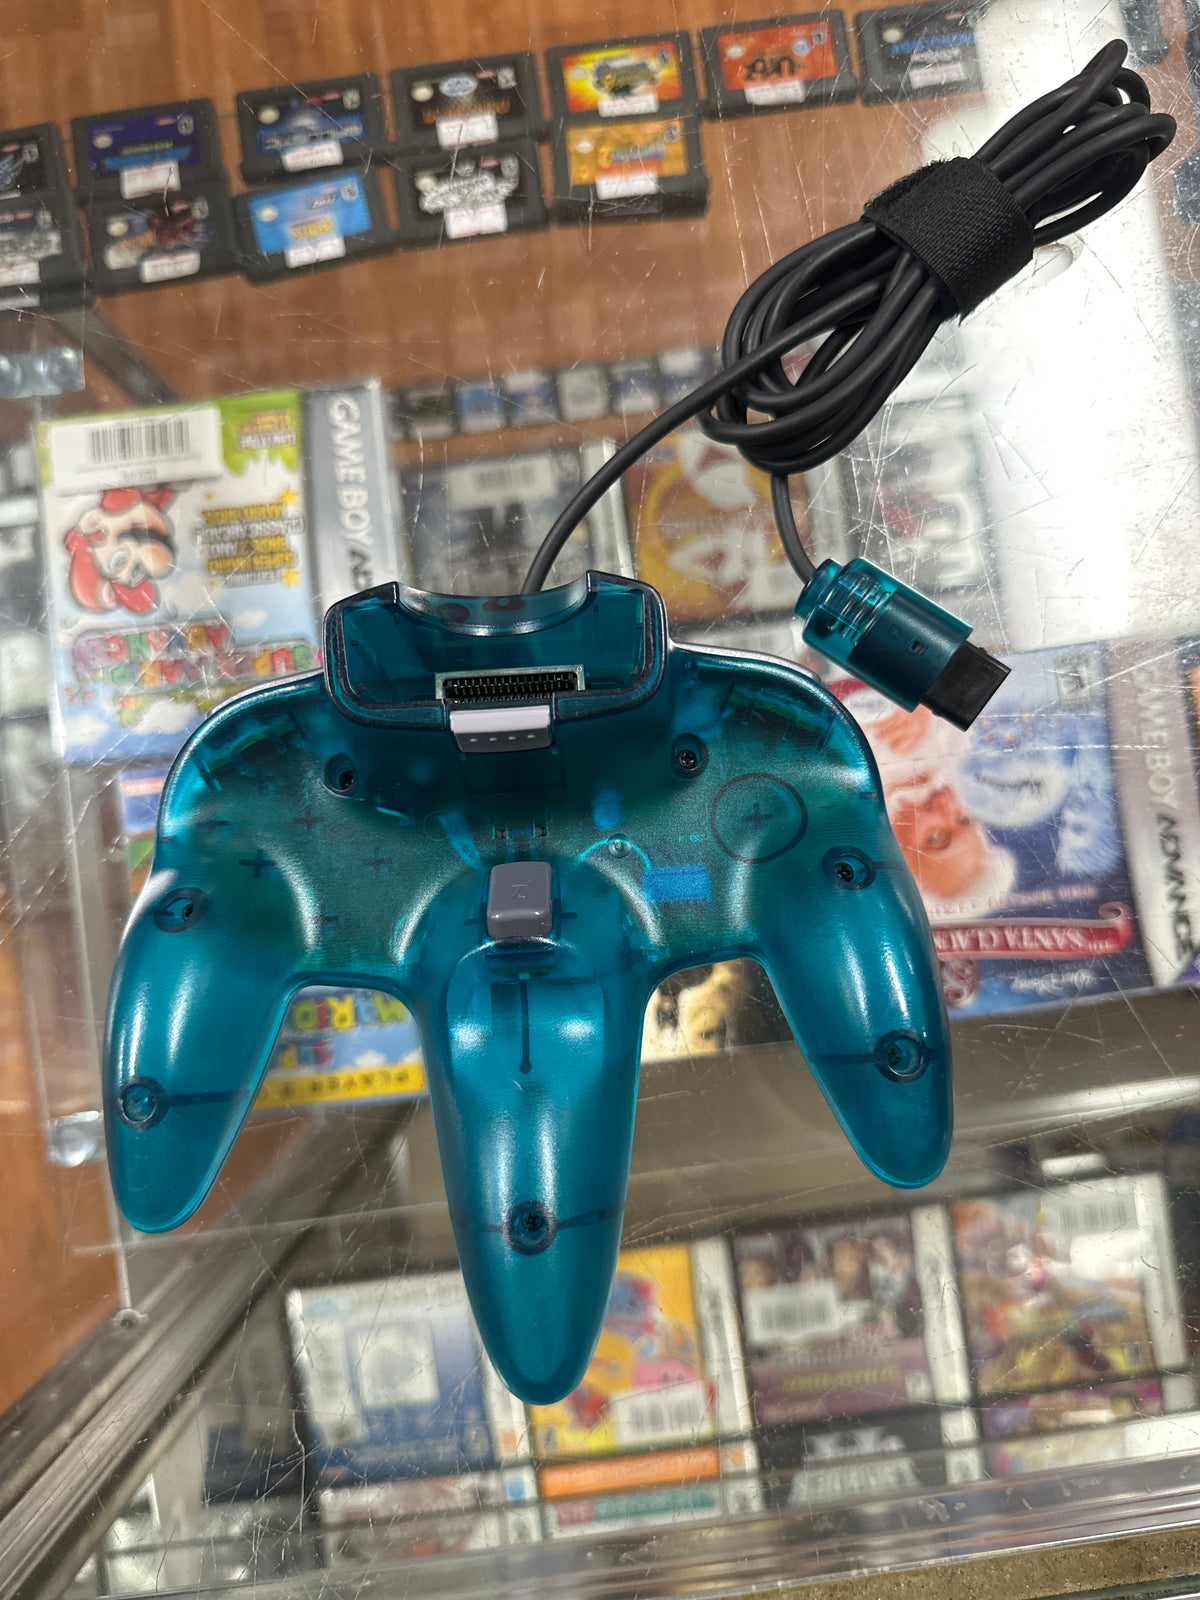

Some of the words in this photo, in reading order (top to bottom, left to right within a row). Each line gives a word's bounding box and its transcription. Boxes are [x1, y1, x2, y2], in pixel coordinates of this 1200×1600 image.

[329, 395, 367, 484] GAME
[338, 484, 374, 546] BOY
[1131, 660, 1168, 748] GAME
[1144, 751, 1178, 810] BOY
[1156, 811, 1194, 963] ADVANCE
[1003, 926, 1084, 950] SANTA
[292, 993, 406, 1032] MARIO
